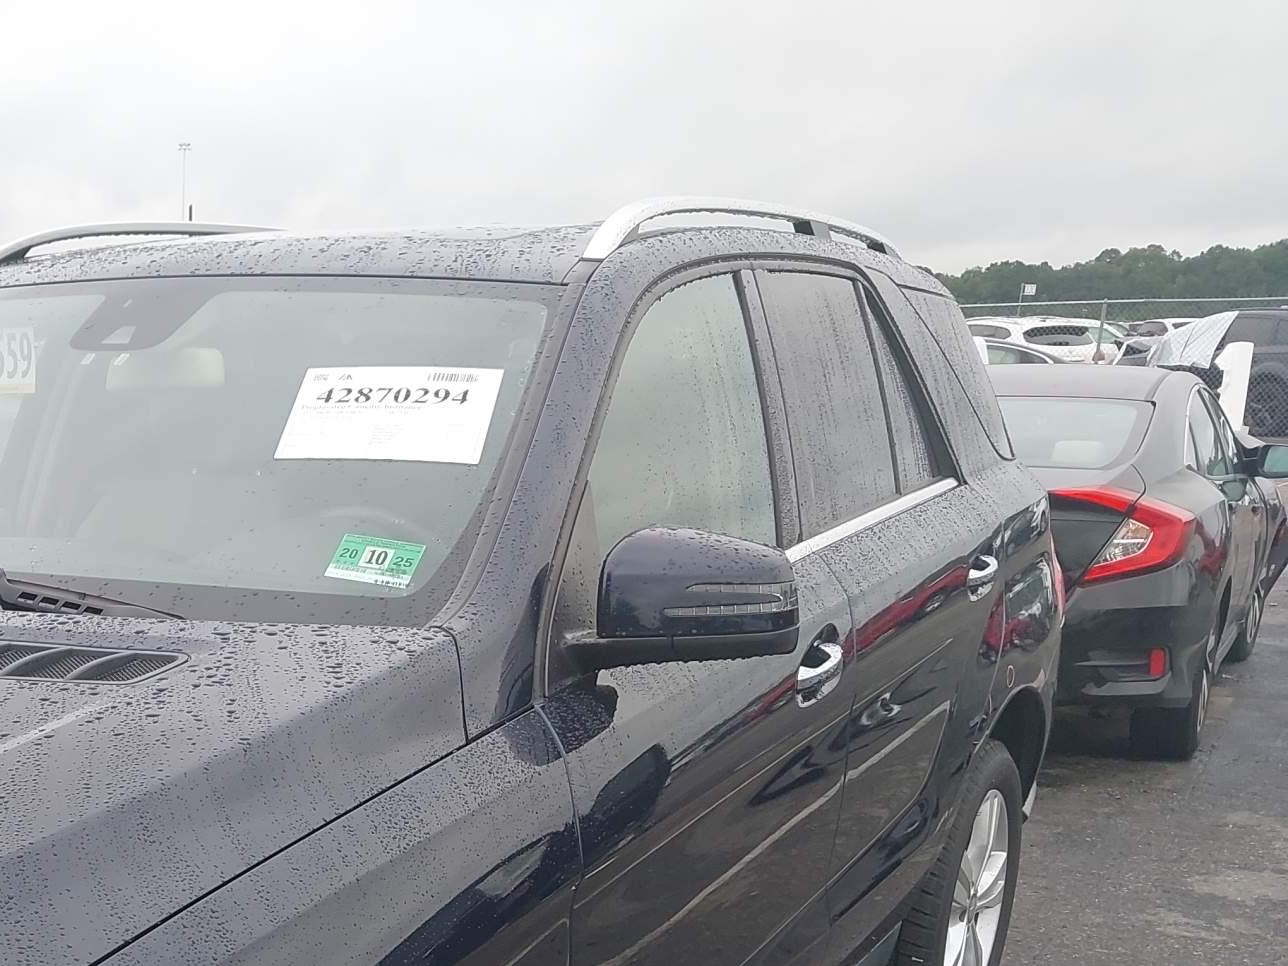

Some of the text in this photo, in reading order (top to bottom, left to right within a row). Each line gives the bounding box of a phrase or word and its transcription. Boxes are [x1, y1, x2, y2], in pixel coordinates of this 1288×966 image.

[315, 387, 470, 404] 42870294
[339, 547, 415, 568] 20 10 25
